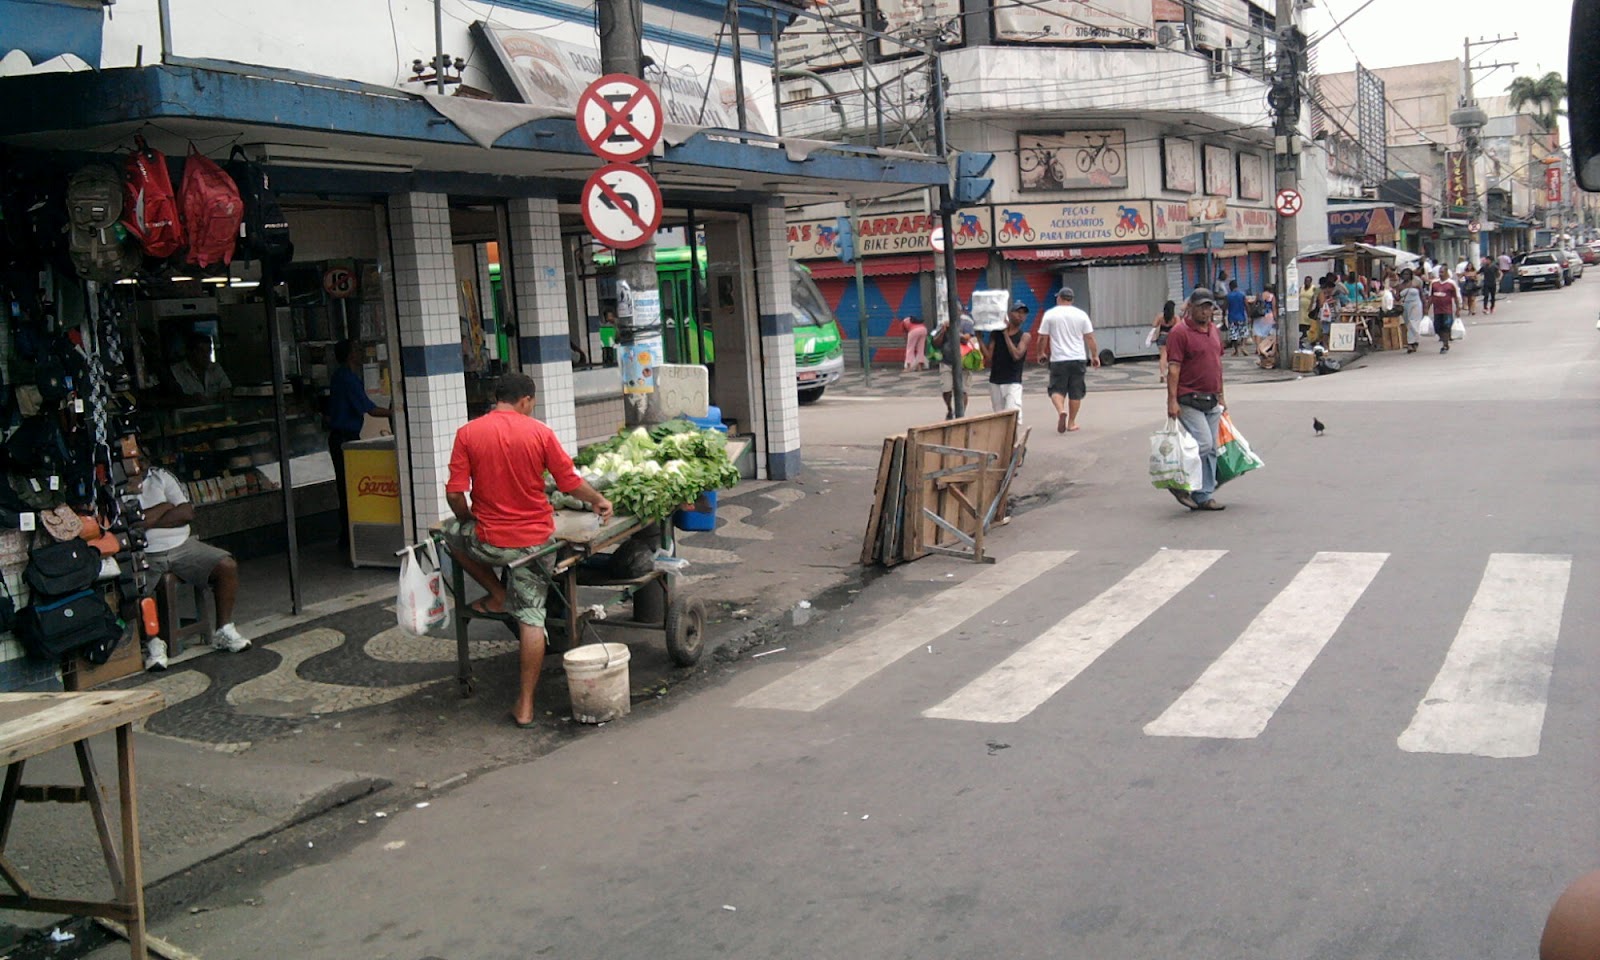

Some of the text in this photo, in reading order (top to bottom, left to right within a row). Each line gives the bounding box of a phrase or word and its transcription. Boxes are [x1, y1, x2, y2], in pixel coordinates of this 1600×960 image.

[604, 94, 634, 143] E
[1091, 205, 1097, 214] E
[1331, 211, 1371, 225] MOP'S
[1039, 229, 1112, 240] PARA BICICLETAS
[864, 238, 889, 251] BIKE
